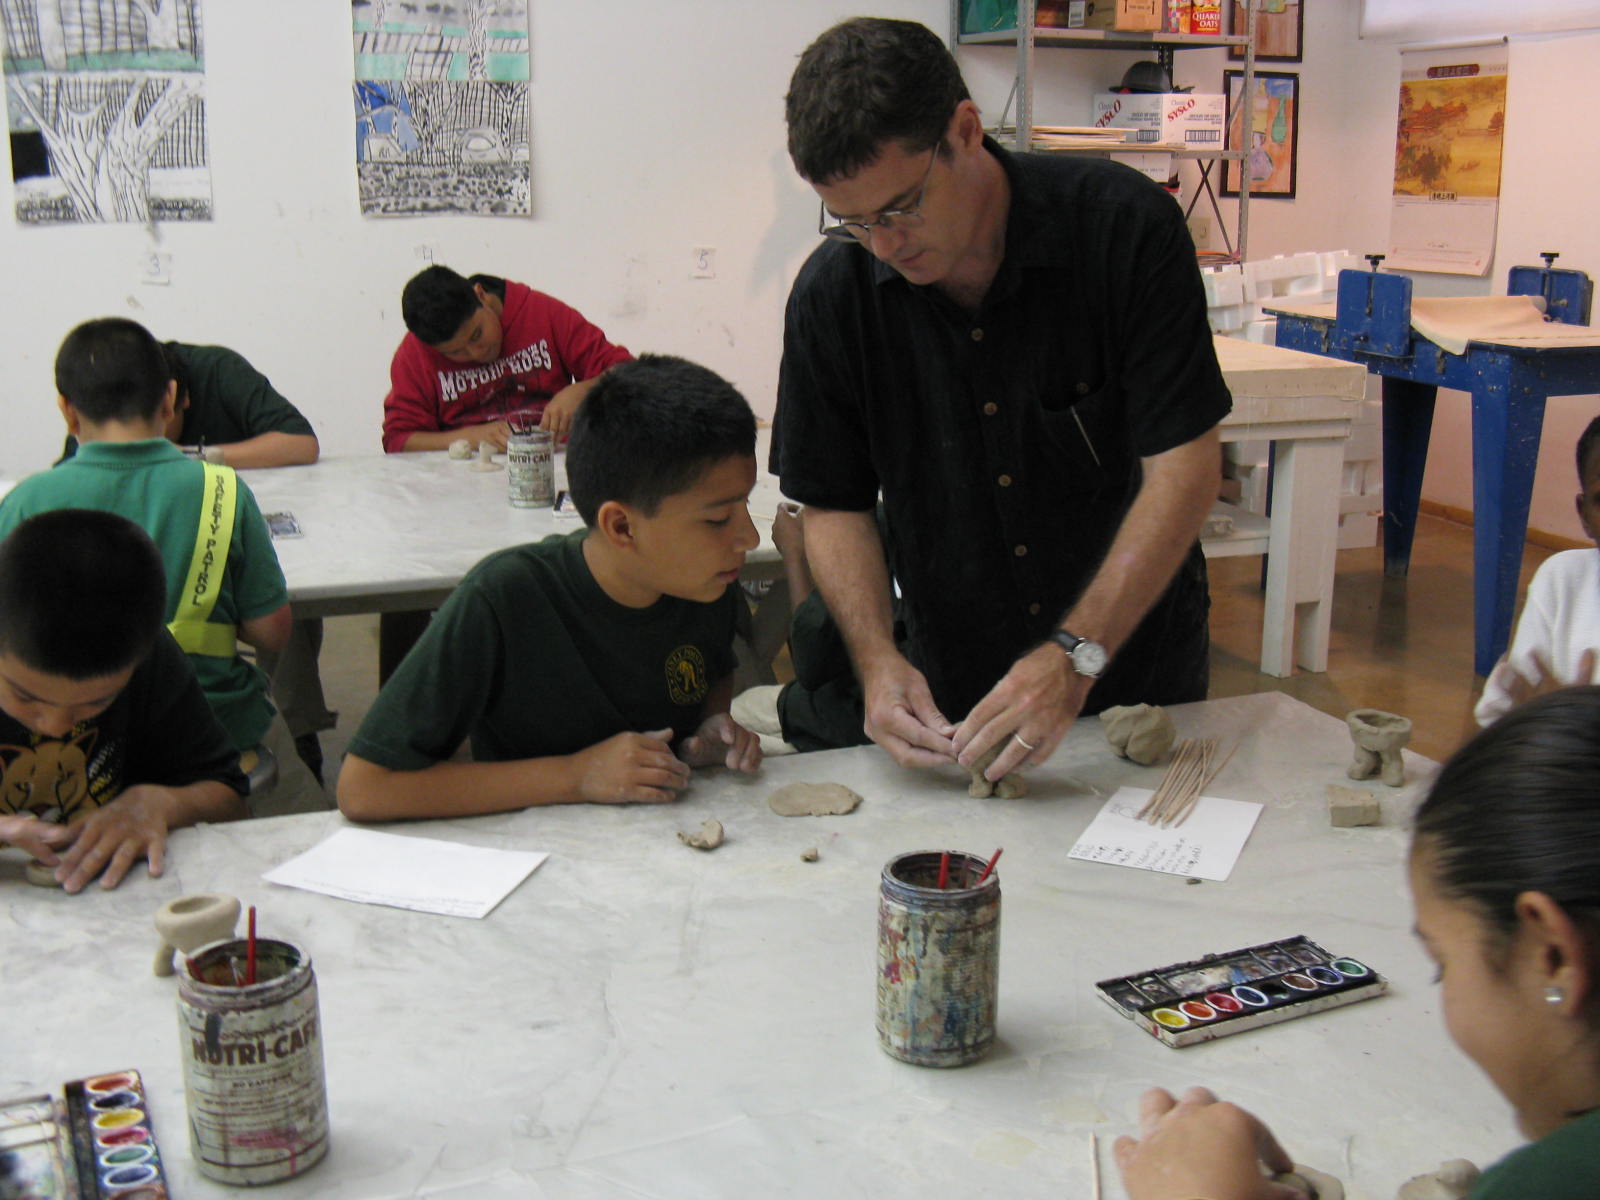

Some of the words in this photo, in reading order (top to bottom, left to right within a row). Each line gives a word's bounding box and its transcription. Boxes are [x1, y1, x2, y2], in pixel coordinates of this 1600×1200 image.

[1200, 20, 1218, 28] OATS
[1167, 98, 1195, 122] SYSCO
[696, 249, 709, 271] 5
[209, 474, 224, 536] SAFETY
[192, 538, 217, 607] PATROL
